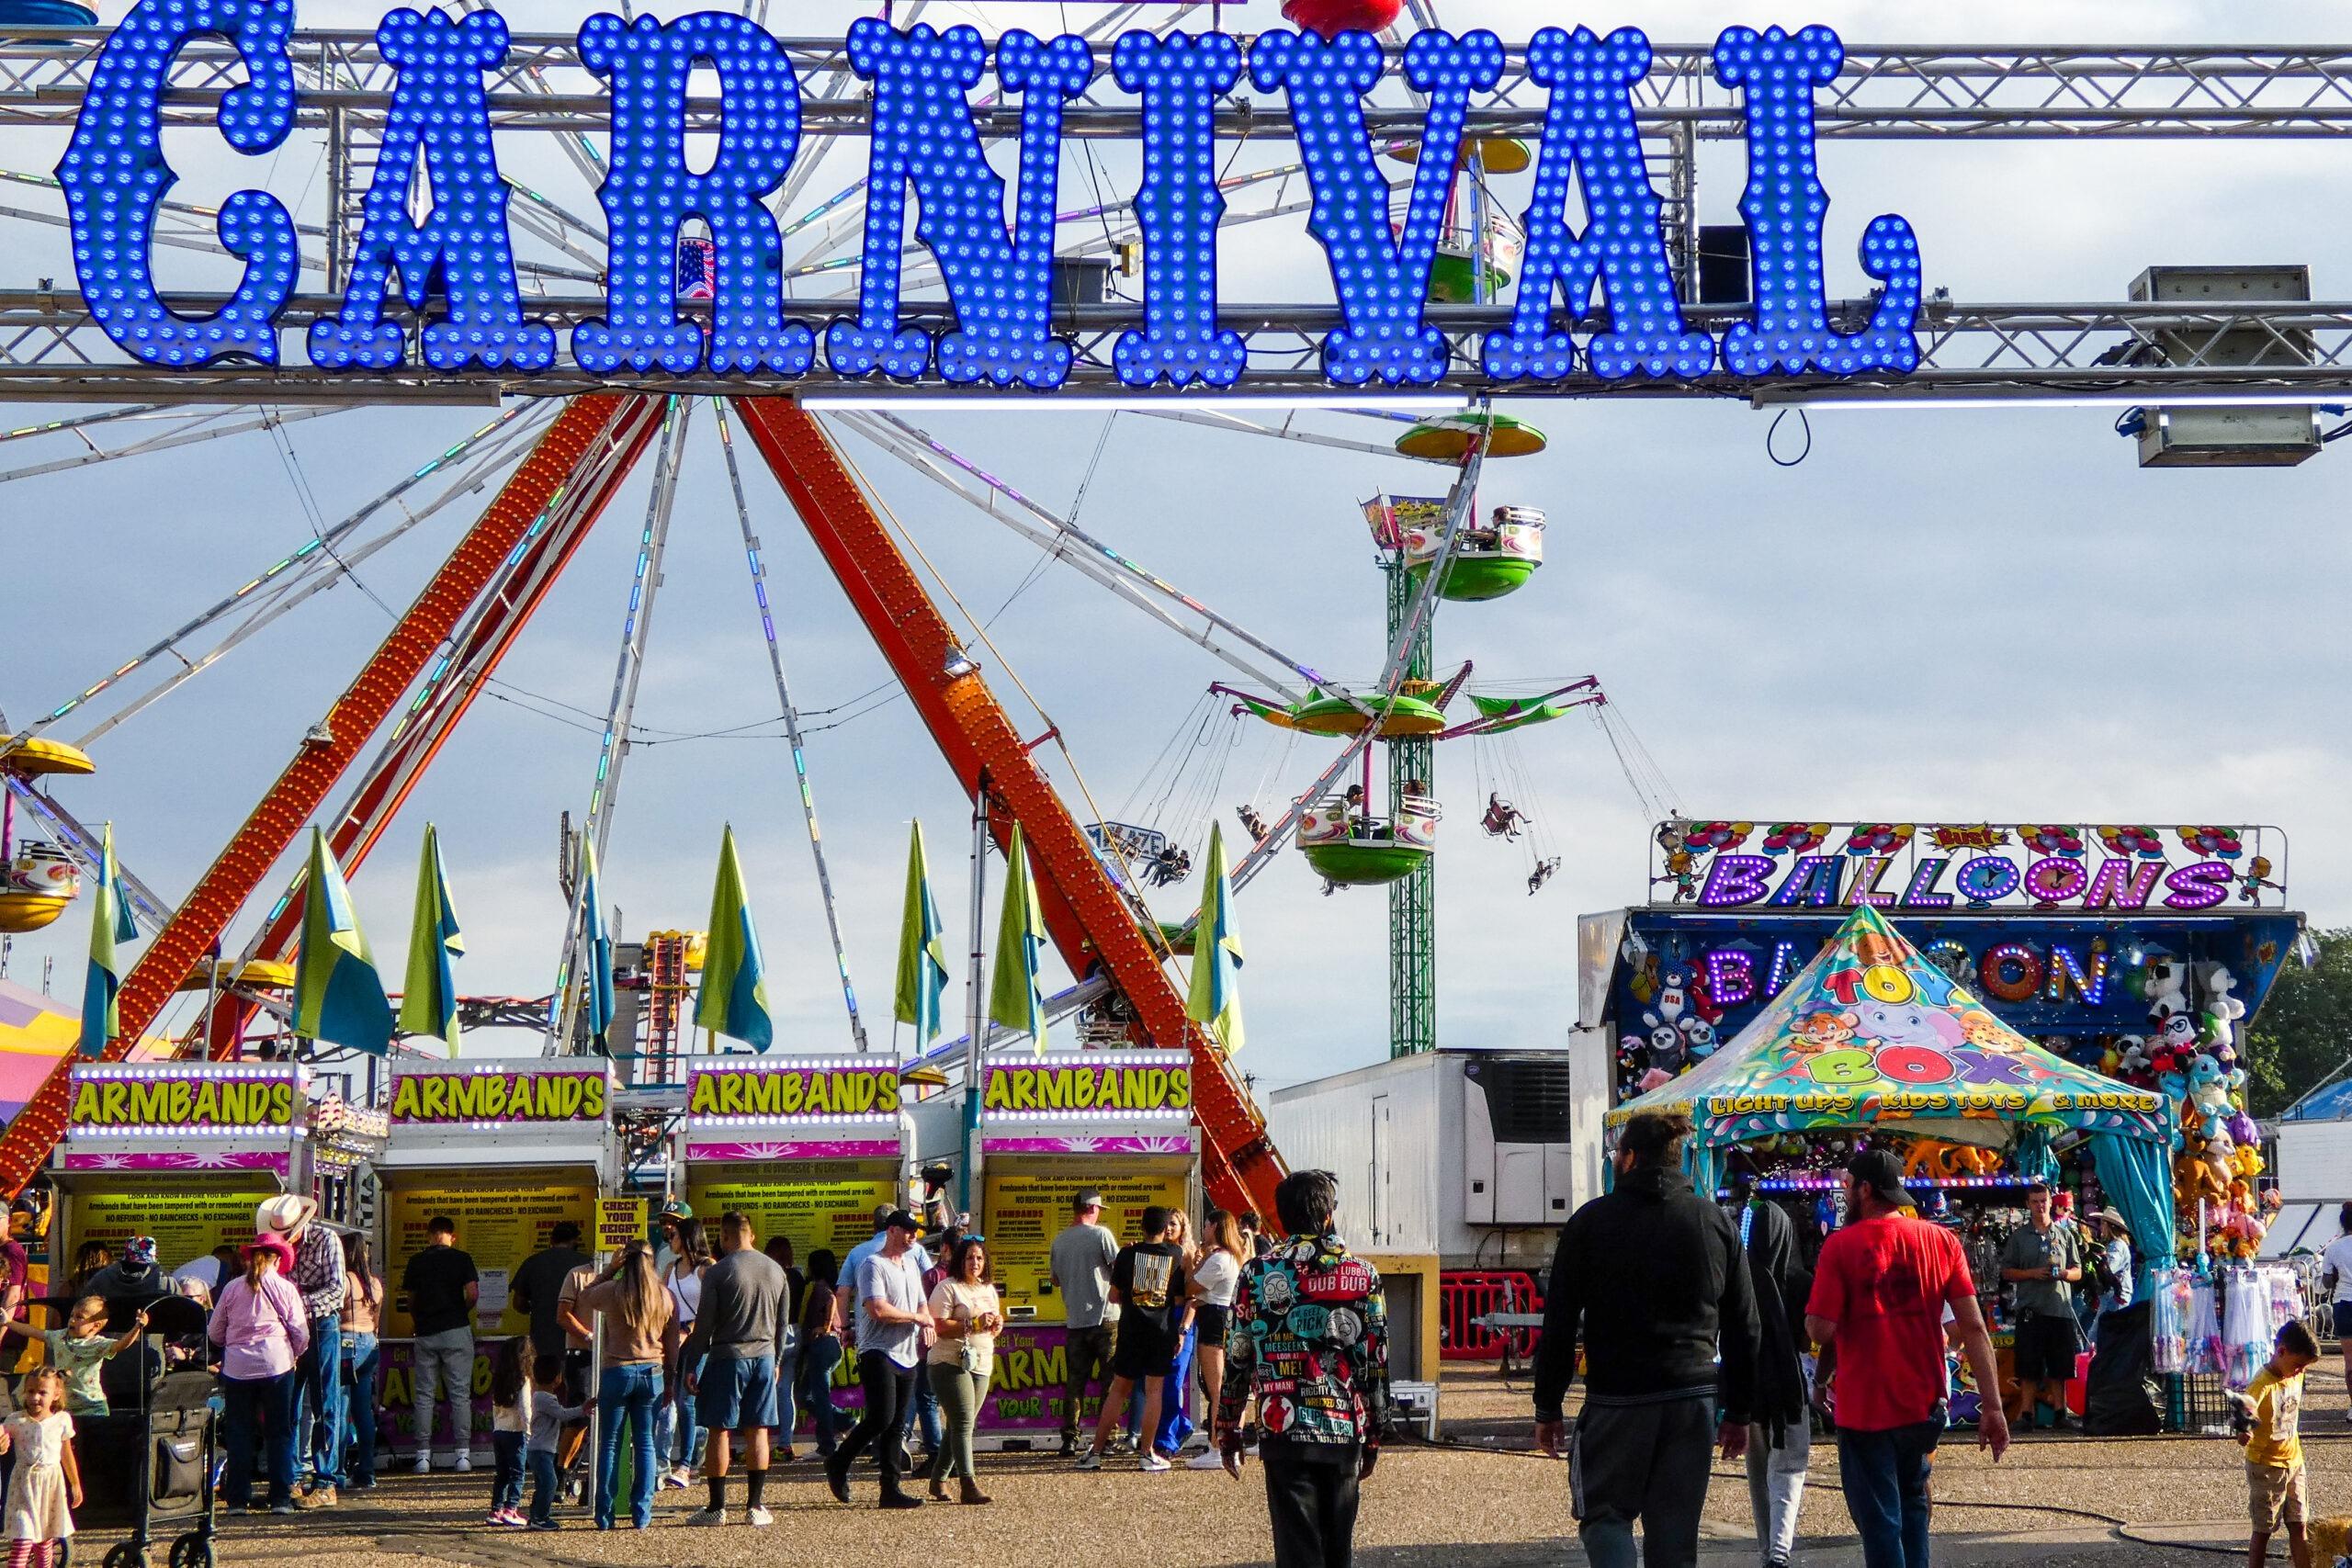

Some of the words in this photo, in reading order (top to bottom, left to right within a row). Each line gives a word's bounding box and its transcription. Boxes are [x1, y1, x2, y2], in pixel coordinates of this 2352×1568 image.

[55, 0, 1922, 389] CARNIVAL
[1697, 854, 2233, 909] BALLOONS
[1821, 964, 1957, 1008] TOY
[1664, 995, 1680, 1005] USA
[1804, 1045, 2037, 1087] BOX
[691, 1070, 898, 1114] ARMBANDS
[984, 1067, 1191, 1111] ARMBANDS
[73, 1080, 292, 1124] ARMBANDS
[391, 1075, 604, 1119] ARMBANDS
[1711, 1094, 1790, 1117] LIGHT
[1795, 1094, 1853, 1111] UPS
[1880, 1093, 1948, 1110] KIDS
[1951, 1093, 2027, 1110] TOYS
[2052, 1093, 2073, 1110] &
[2075, 1092, 2157, 1112] MORE
[735, 1190, 746, 1198] that
[777, 1189, 806, 1197] tampered
[1143, 1183, 1152, 1191] are
[406, 1196, 435, 1204] Armbands
[436, 1196, 448, 1204] that
[480, 1195, 508, 1203] tampered
[556, 1194, 566, 1202] are
[603, 1201, 638, 1211] CHECK
[106, 1214, 115, 1223] NO
[117, 1214, 144, 1223] REFUNDS
[150, 1213, 158, 1222] NO
[160, 1213, 198, 1222] RAINCHECKS
[424, 1208, 432, 1216] NO
[605, 1213, 634, 1222] YOUR
[600, 1224, 640, 1233] HEIGHT
[1340, 1265, 1366, 1276] LUBBA
[1307, 1276, 1336, 1292] DUB
[1340, 1277, 1367, 1292] DUB
[1296, 1316, 1323, 1331] RICK
[1279, 1361, 1302, 1376] ME!
[1263, 1383, 1274, 1393] MY
[998, 1396, 1043, 1417] YOUR
